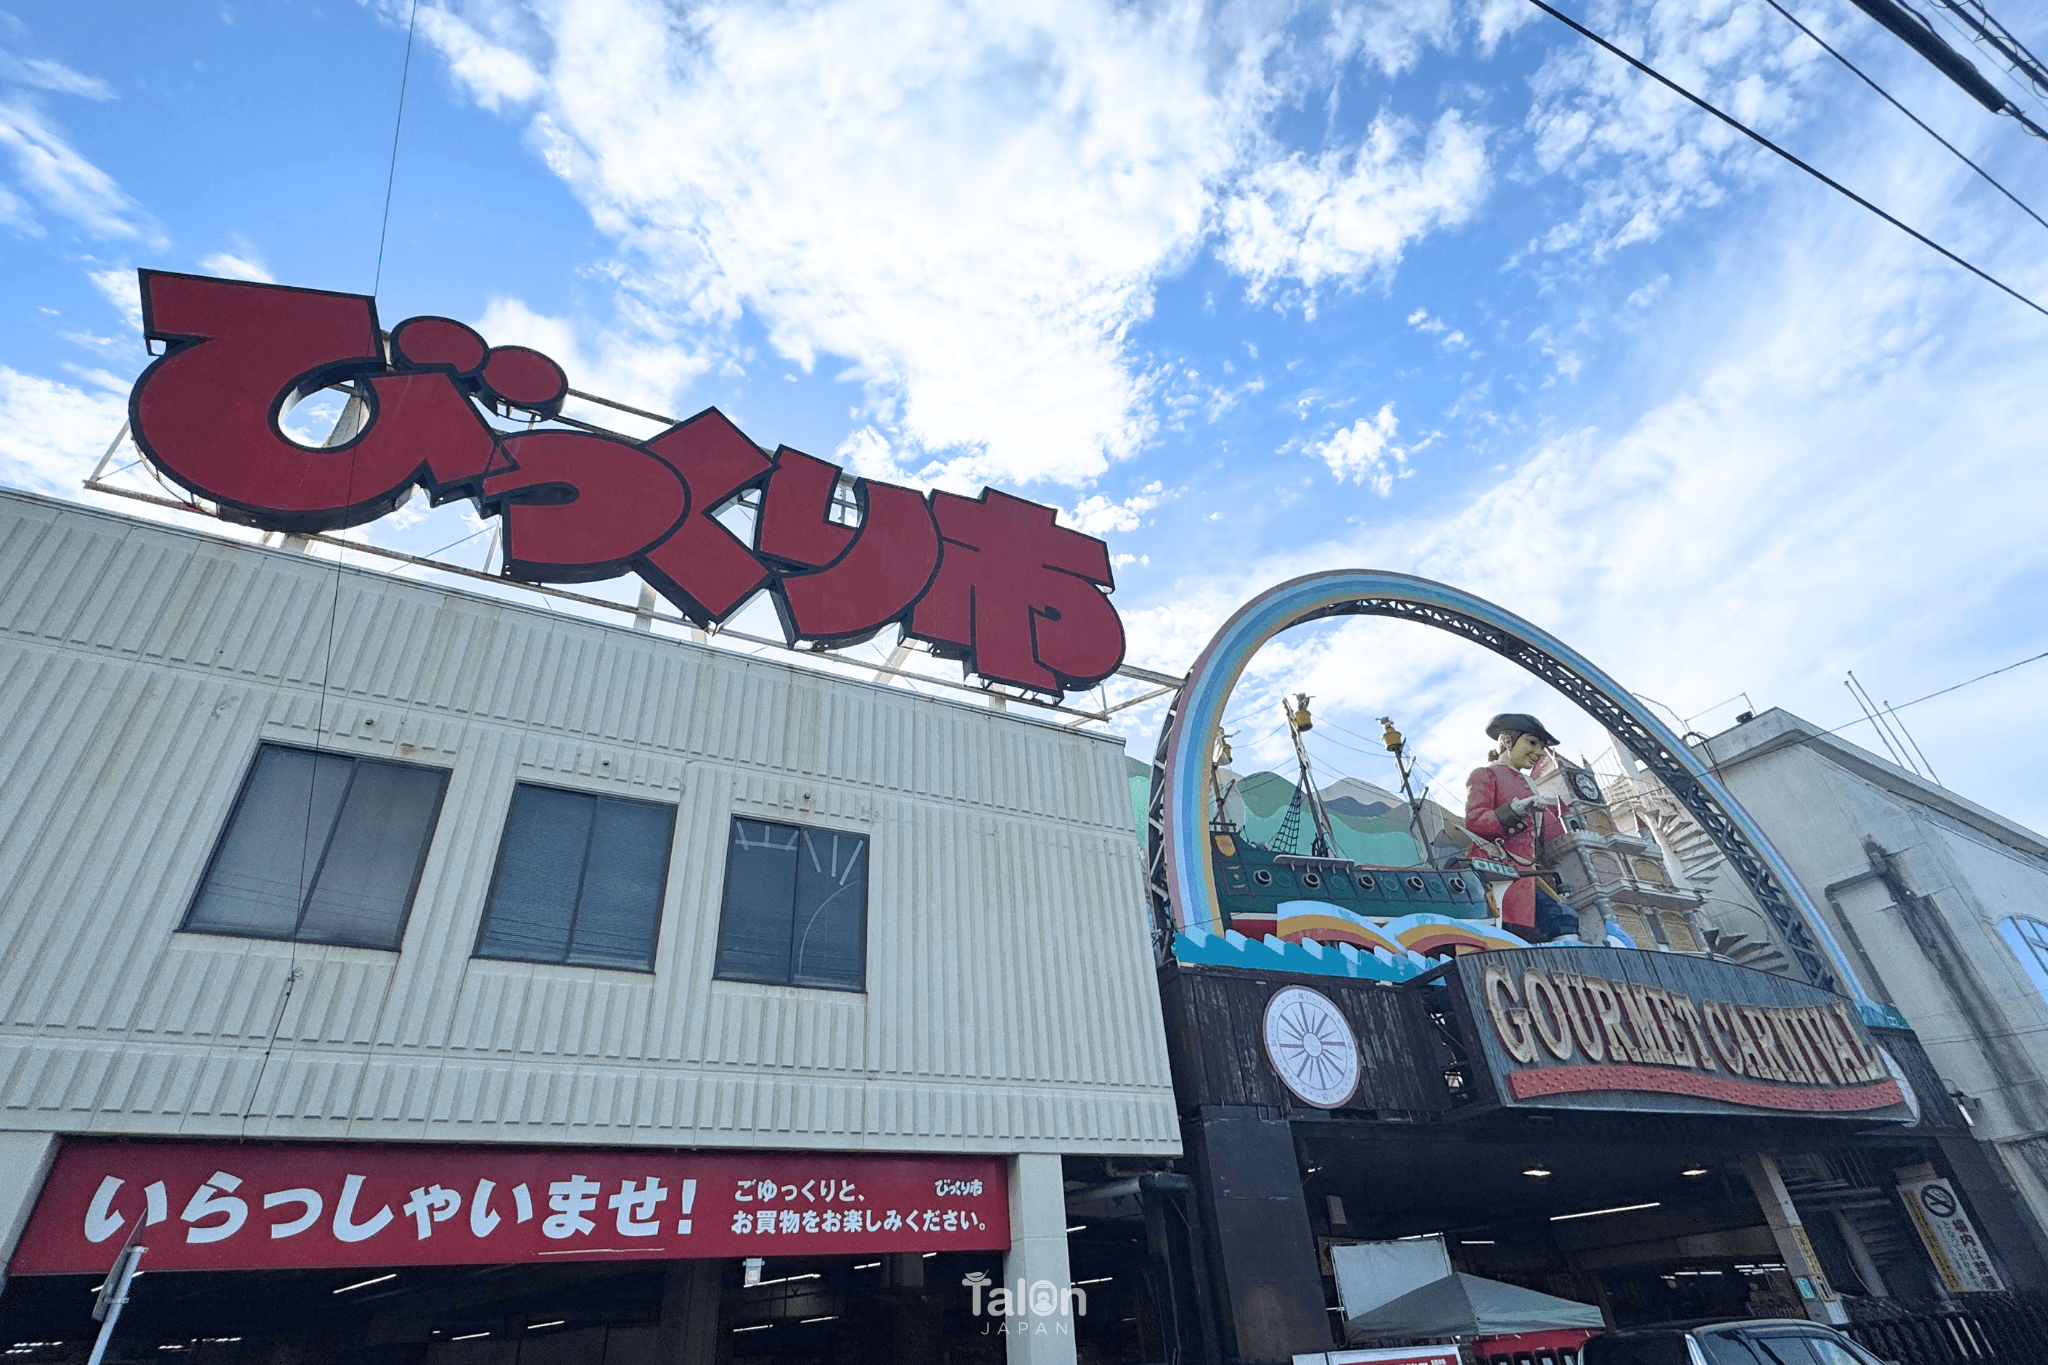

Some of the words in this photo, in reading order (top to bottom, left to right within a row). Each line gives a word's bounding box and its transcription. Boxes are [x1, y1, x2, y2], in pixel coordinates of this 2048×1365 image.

[127, 267, 1126, 700] びっくり市
[1485, 962, 1717, 1071] GOURMET
[1702, 998, 1888, 1086] CARNIVAL
[84, 1170, 697, 1244] いらっしゃいませ！
[734, 1178, 865, 1203] ごゆっくりと、
[934, 1178, 983, 1197] びっくり市
[731, 1208, 986, 1235] お買物をお楽しみください。
